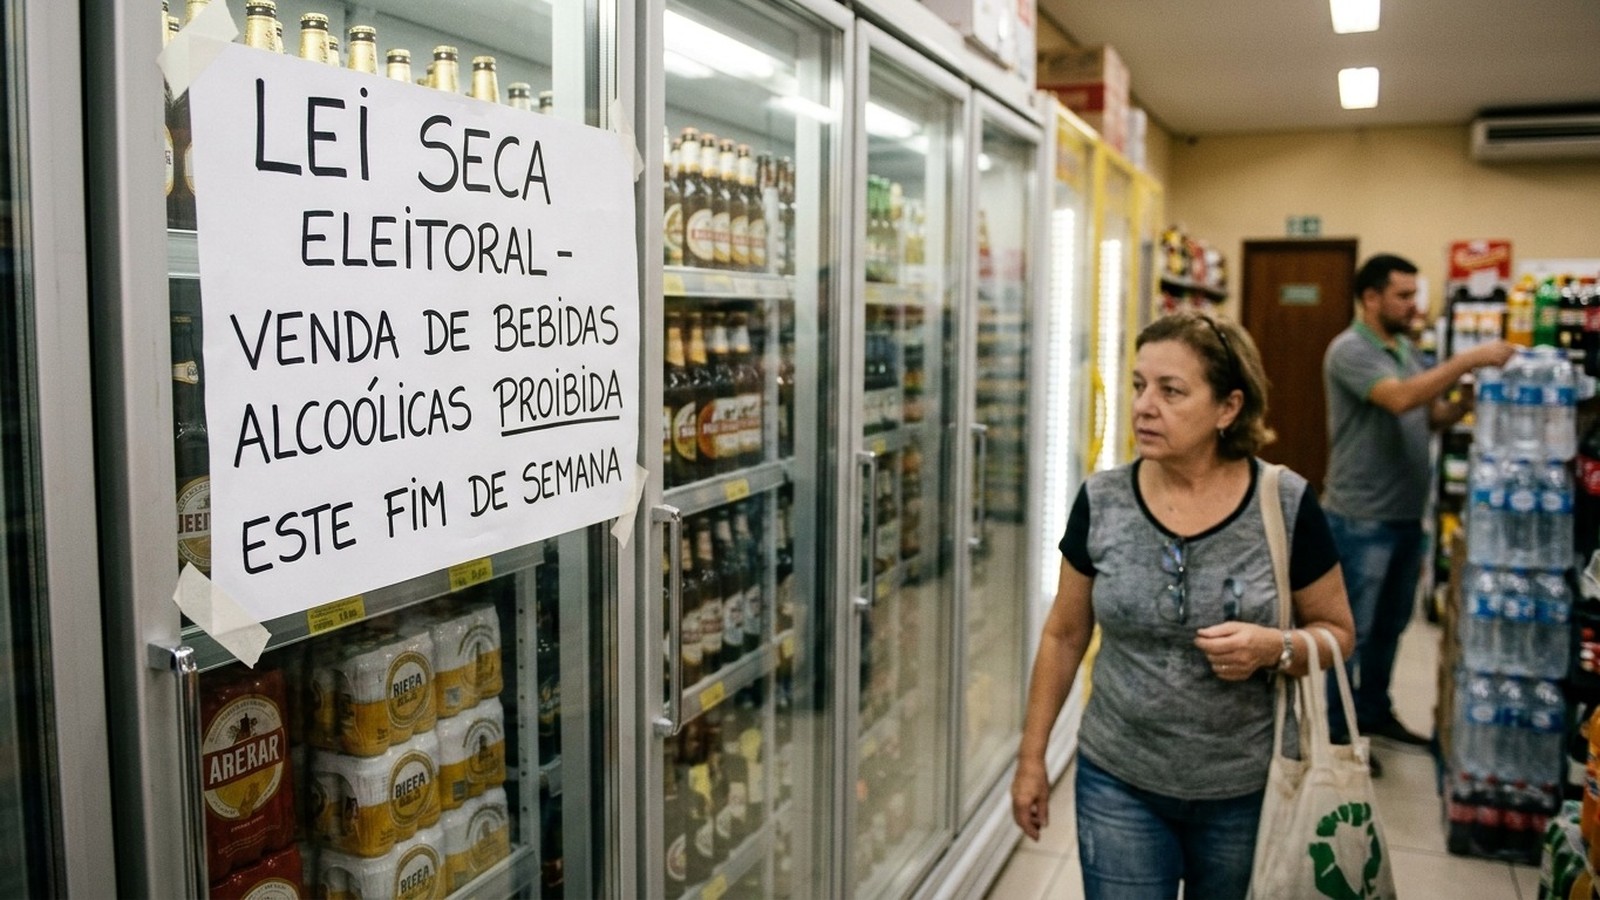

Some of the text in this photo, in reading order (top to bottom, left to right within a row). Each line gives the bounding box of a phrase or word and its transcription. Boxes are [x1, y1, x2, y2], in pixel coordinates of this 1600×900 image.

[255, 79, 551, 205] LEI SECA
[301, 206, 548, 277] ELEITORAL
[229, 296, 619, 371] VENDA DE BEBIDAS
[233, 365, 623, 468] ALCOÓLICAS PROIBIDA
[242, 446, 622, 575] ESTE FIM DE SEMANA
